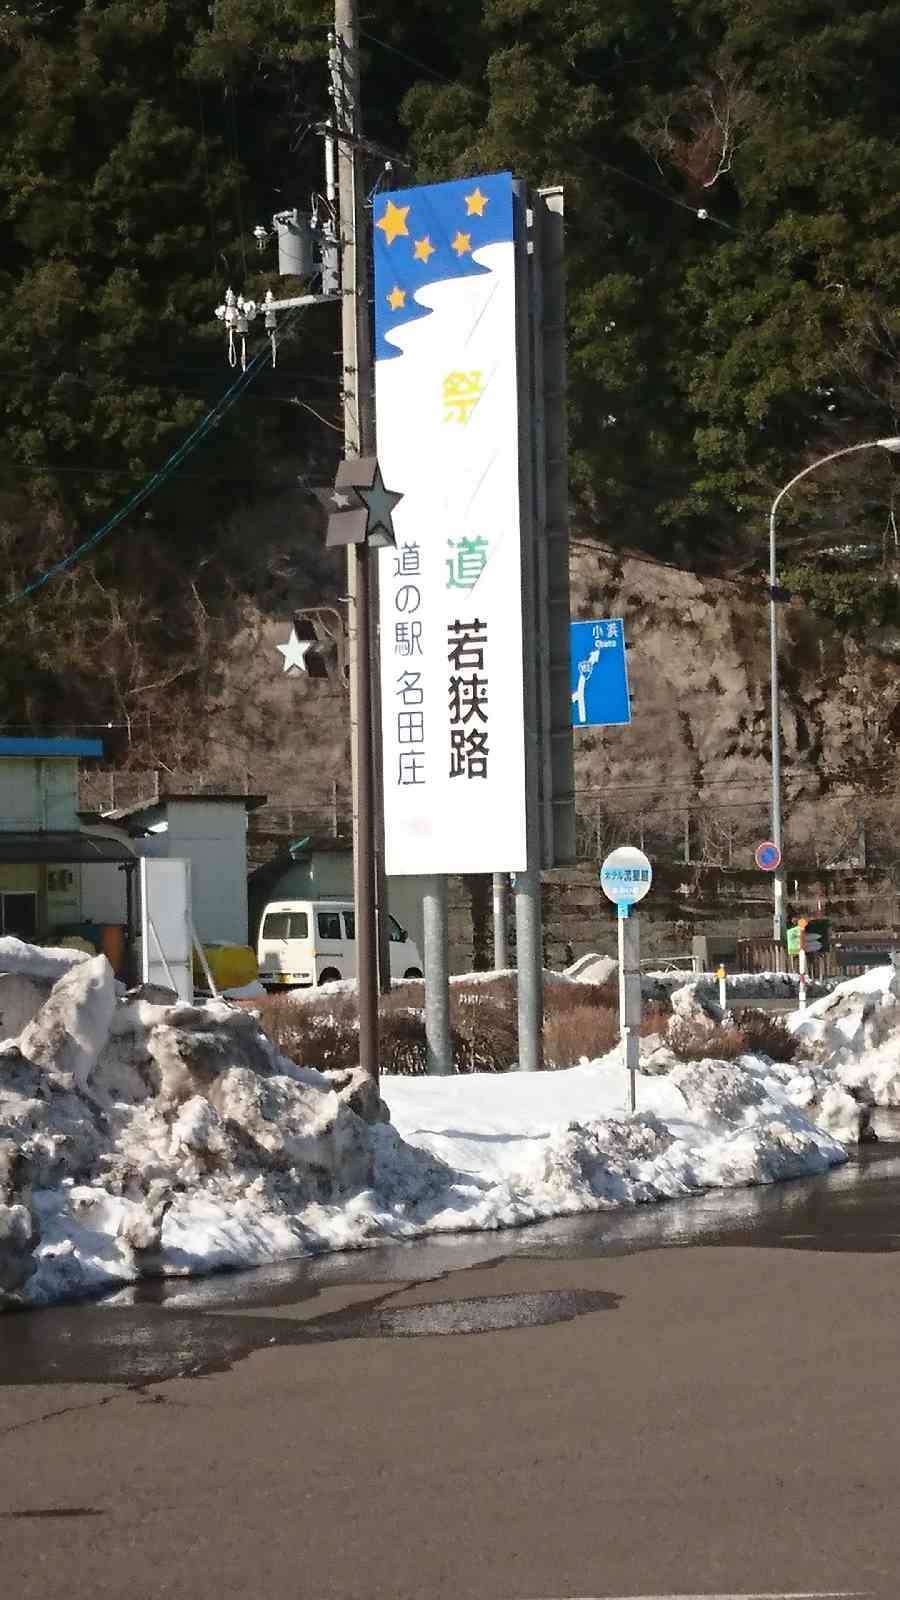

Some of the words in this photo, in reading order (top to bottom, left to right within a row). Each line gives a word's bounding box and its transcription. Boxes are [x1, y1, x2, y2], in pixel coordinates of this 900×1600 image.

[442, 370, 484, 424] 祭
[393, 541, 423, 656] 道の駅
[445, 535, 489, 589] 道
[592, 623, 619, 640] 小浜
[396, 670, 426, 786] 名田庄
[447, 618, 490, 779] 若狭路
